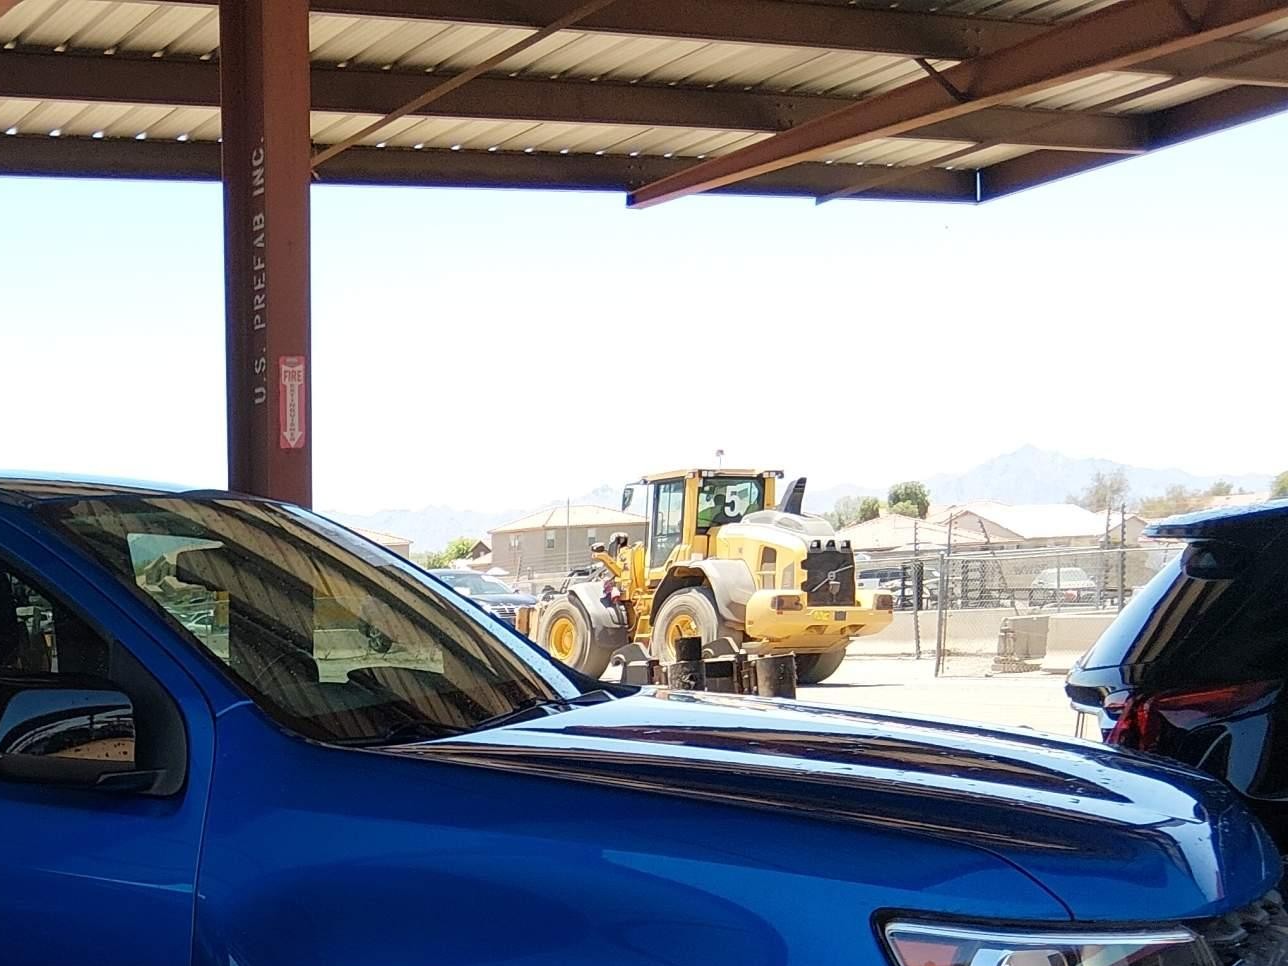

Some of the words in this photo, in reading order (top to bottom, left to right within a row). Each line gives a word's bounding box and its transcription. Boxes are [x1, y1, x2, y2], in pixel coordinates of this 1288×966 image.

[252, 135, 265, 198] INC.
[253, 212, 266, 331] PREFAB
[254, 346, 267, 405] U.S.
[283, 369, 303, 383] FIRE
[724, 484, 743, 517] 5
